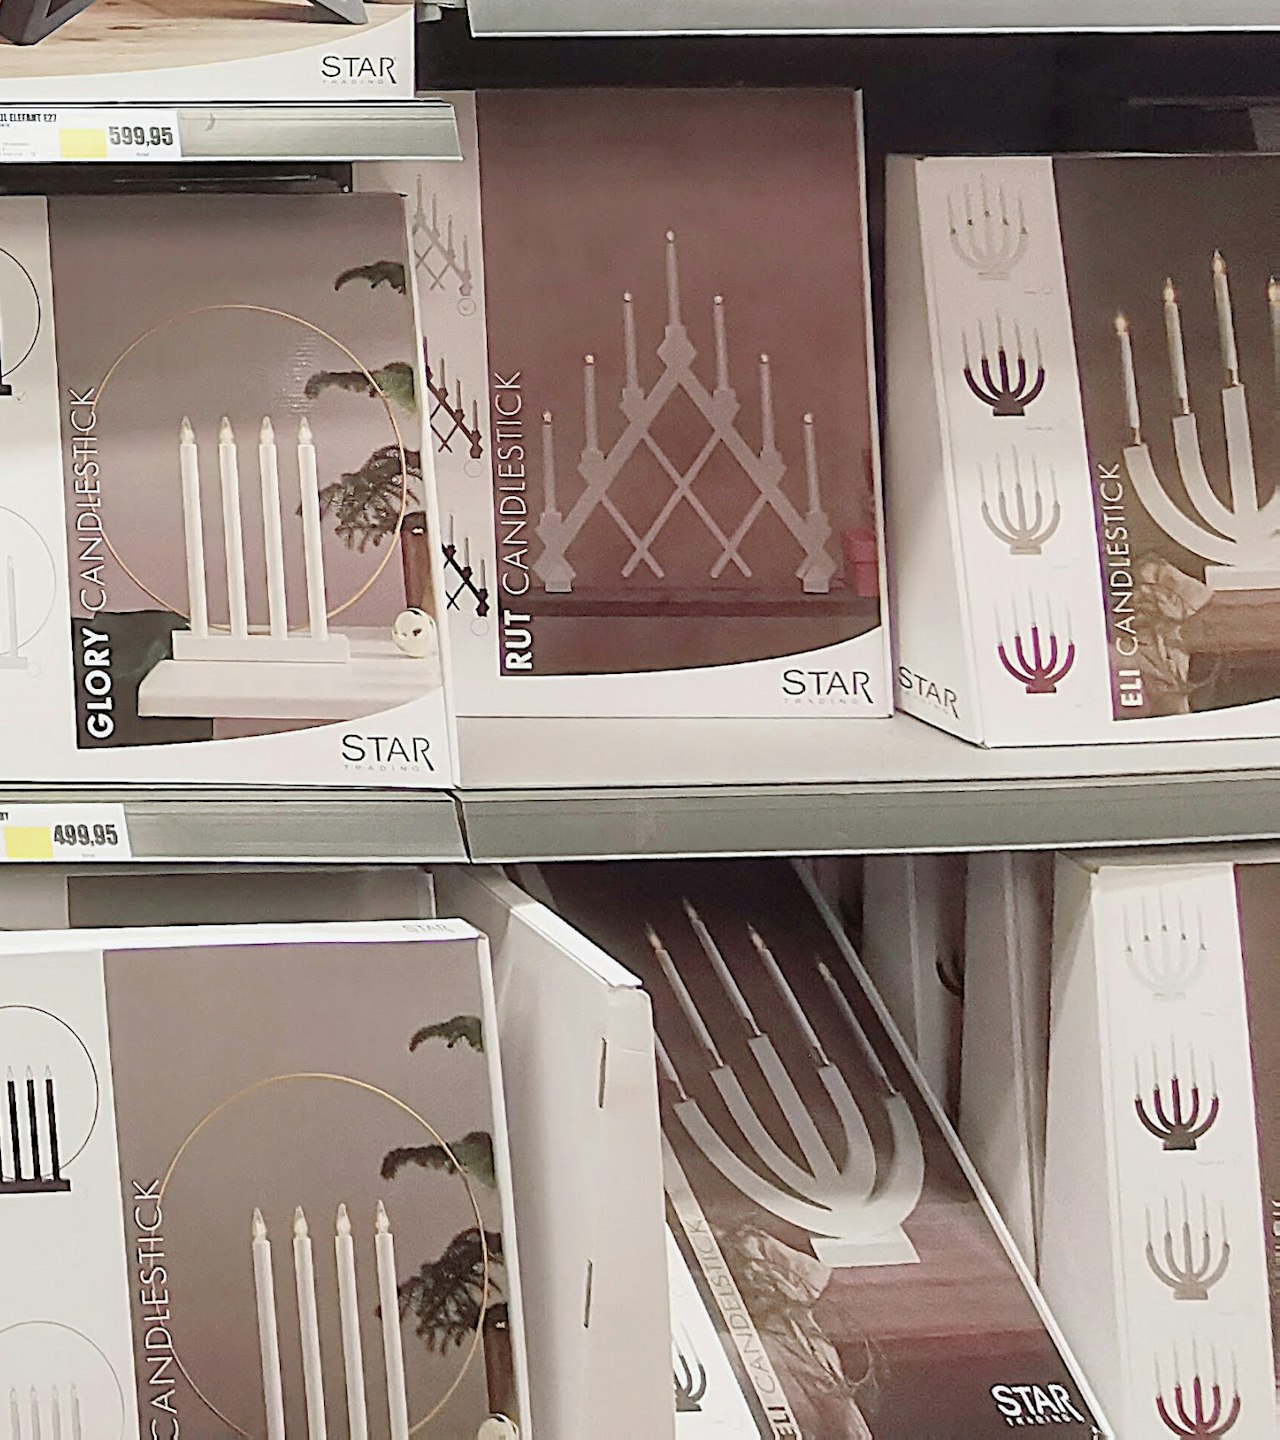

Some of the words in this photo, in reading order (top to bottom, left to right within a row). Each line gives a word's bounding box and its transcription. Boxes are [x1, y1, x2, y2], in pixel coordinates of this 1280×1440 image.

[321, 55, 397, 85] STAR
[108, 126, 173, 146] 599,95
[67, 386, 107, 613] CANDLESTICK
[493, 370, 530, 597] CANDLESTICK
[1098, 463, 1134, 658] CANDLESTICK
[504, 609, 533, 671] RUT
[84, 627, 113, 740] GLORY
[781, 668, 873, 704] STAR
[899, 666, 960, 720] STAR
[1119, 668, 1144, 707] ELI
[342, 734, 435, 770] STAR
[54, 824, 118, 847] 499,95
[133, 1180, 179, 1440] CANDLESTICK
[684, 1217, 776, 1394] CANDELSTICK
[991, 1384, 1083, 1423] STAR
